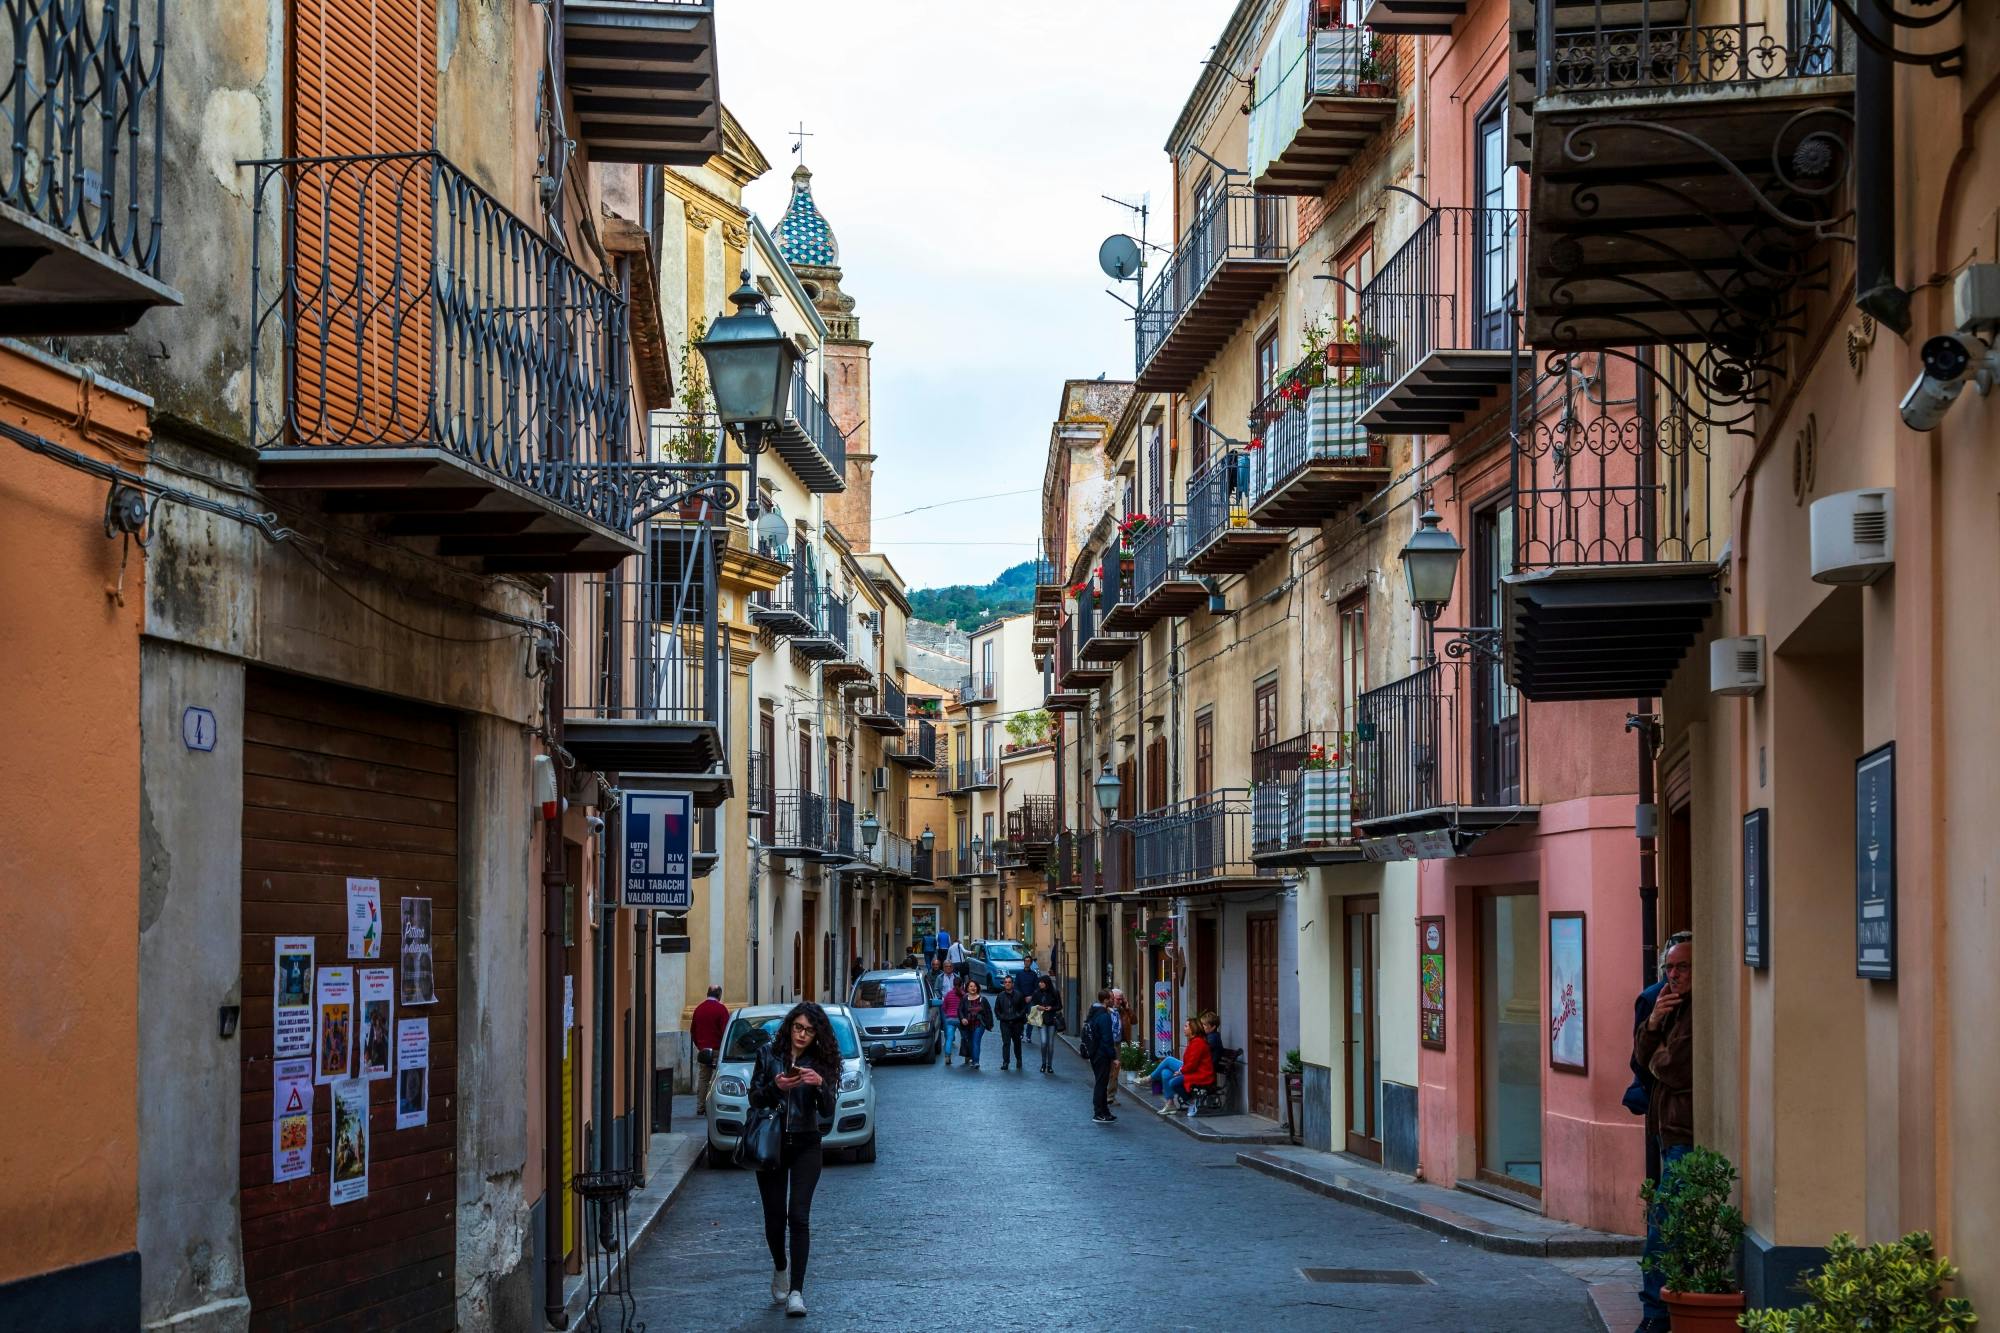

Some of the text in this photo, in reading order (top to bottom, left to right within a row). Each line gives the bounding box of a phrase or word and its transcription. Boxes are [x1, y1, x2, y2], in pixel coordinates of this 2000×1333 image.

[194, 714, 204, 745] 4
[632, 798, 683, 874] T
[630, 842, 648, 850] LOTTO
[667, 853, 684, 862] RIV.
[671, 864, 678, 873] 4
[628, 878, 685, 891] SALI TABACCHI
[627, 892, 685, 904] VALORI BOLLATI
